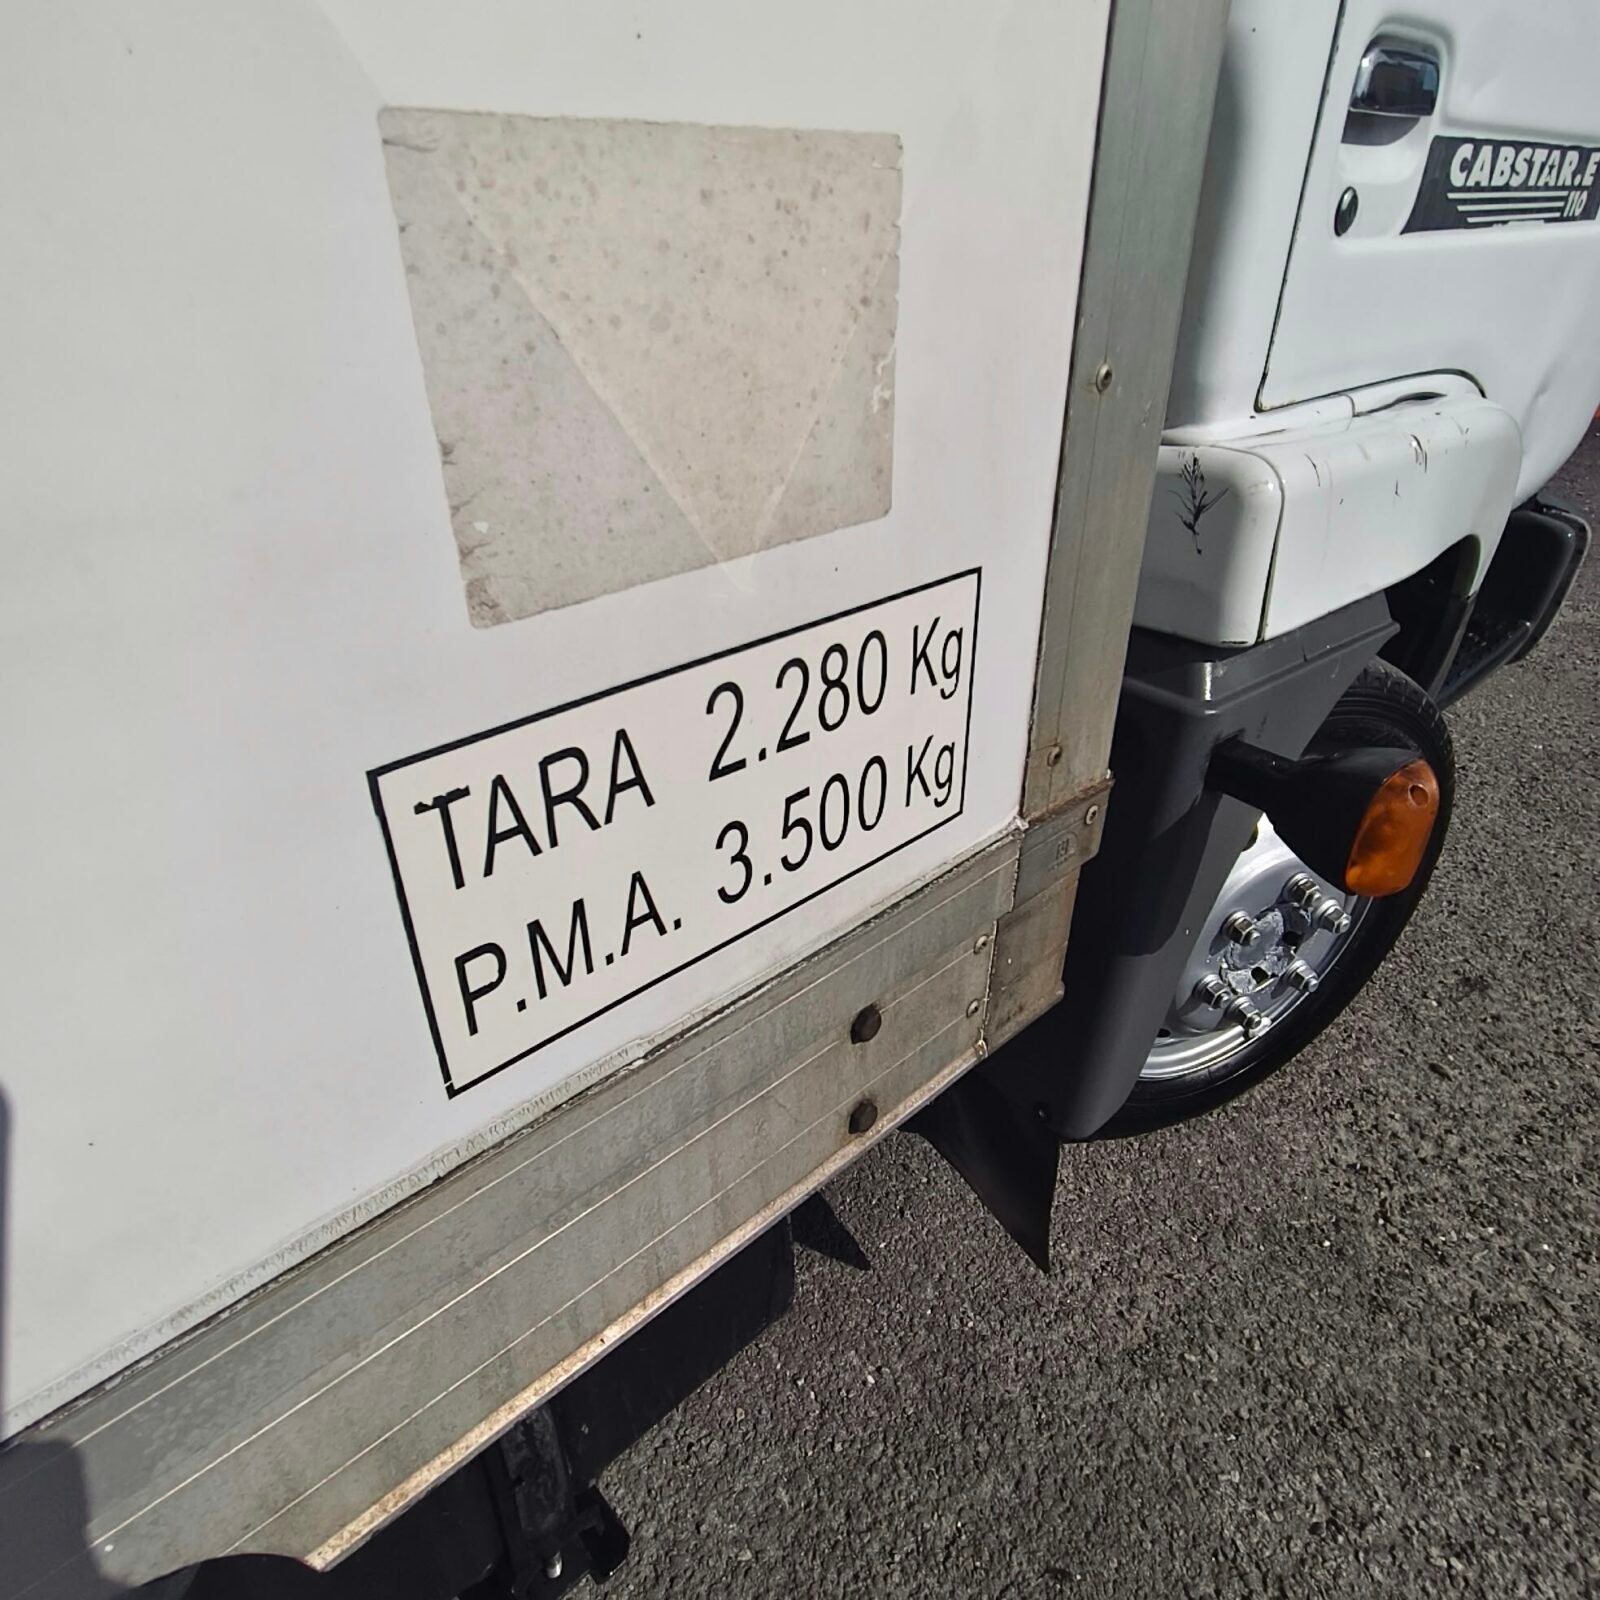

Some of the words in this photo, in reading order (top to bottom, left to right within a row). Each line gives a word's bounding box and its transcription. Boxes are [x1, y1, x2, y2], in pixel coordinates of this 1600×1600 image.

[1449, 143, 1600, 188] CABSTAR.E
[1563, 190, 1588, 217] 110
[413, 728, 656, 890] TARA
[705, 629, 889, 782] 2.280
[910, 616, 964, 700] Kg
[454, 870, 683, 1037] P.M.A.
[715, 755, 888, 904] 3.500
[905, 735, 956, 808] Kg
